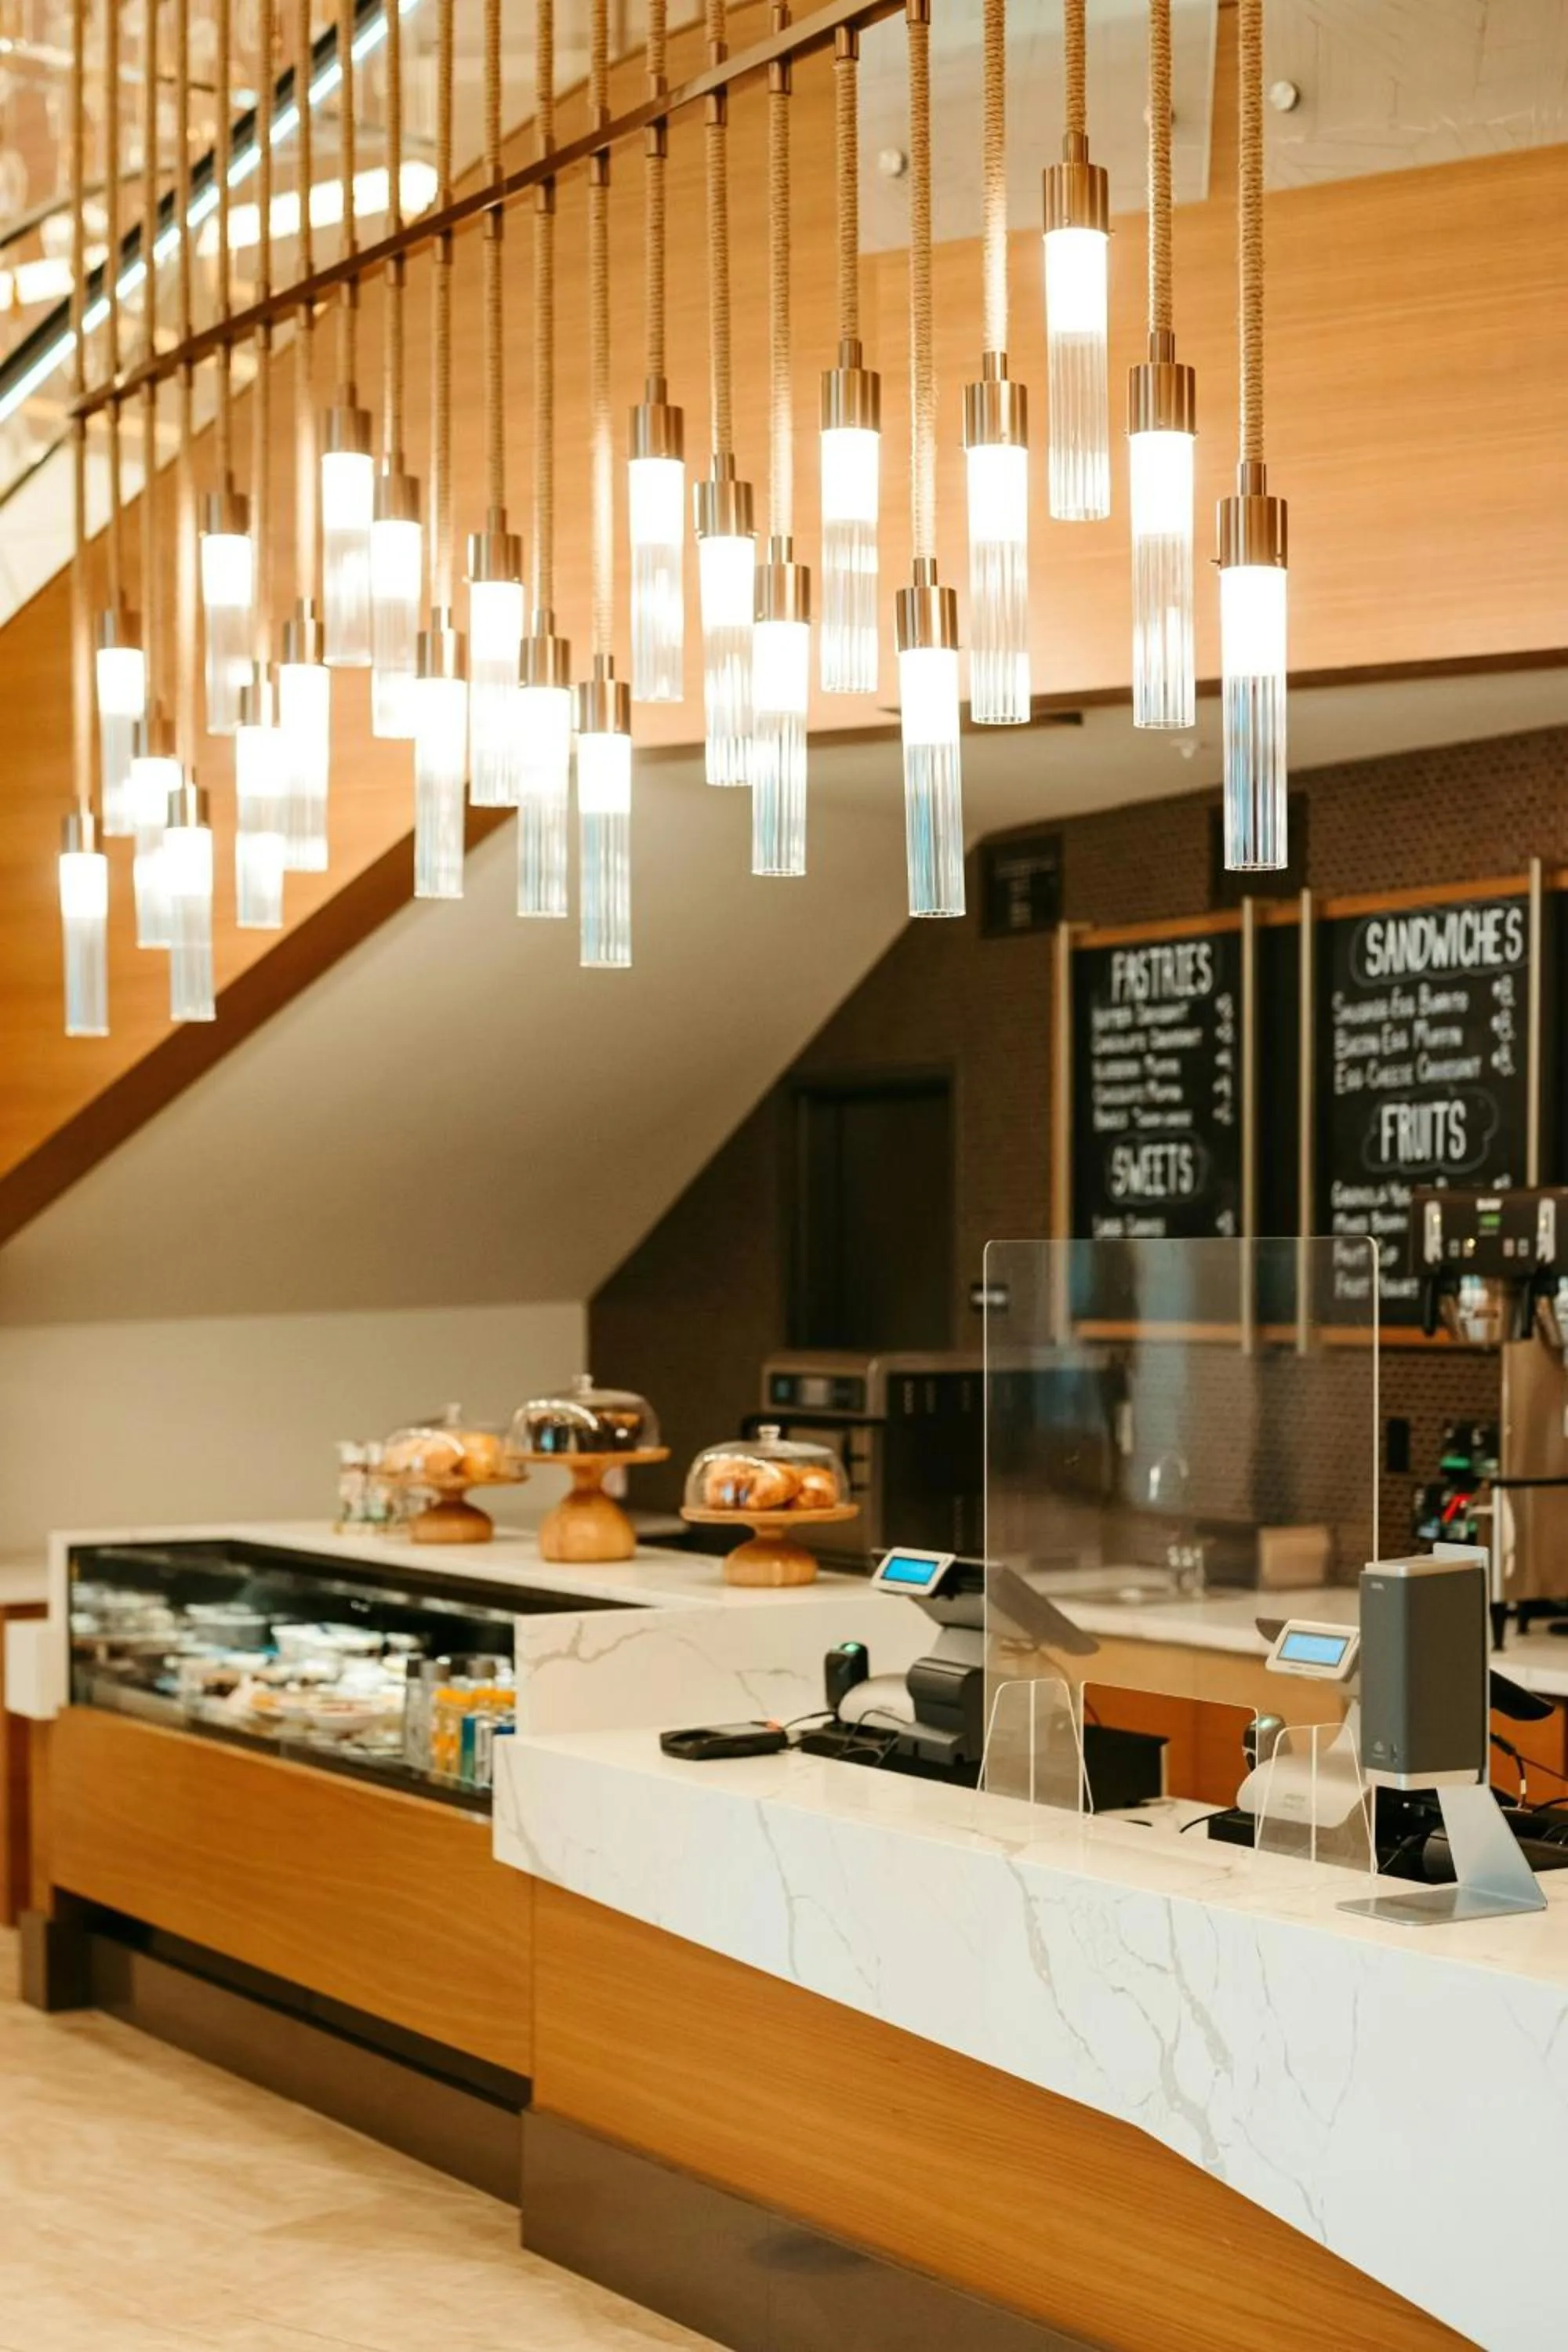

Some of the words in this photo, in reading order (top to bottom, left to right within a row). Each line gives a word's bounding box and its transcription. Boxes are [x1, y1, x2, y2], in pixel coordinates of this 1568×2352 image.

[1111, 942, 1214, 1004] PASTRIES
[1366, 907, 1523, 977] SANDWICHES
[1381, 1100, 1467, 1162] FRUITS
[1111, 1143, 1193, 1196] SWEETS
